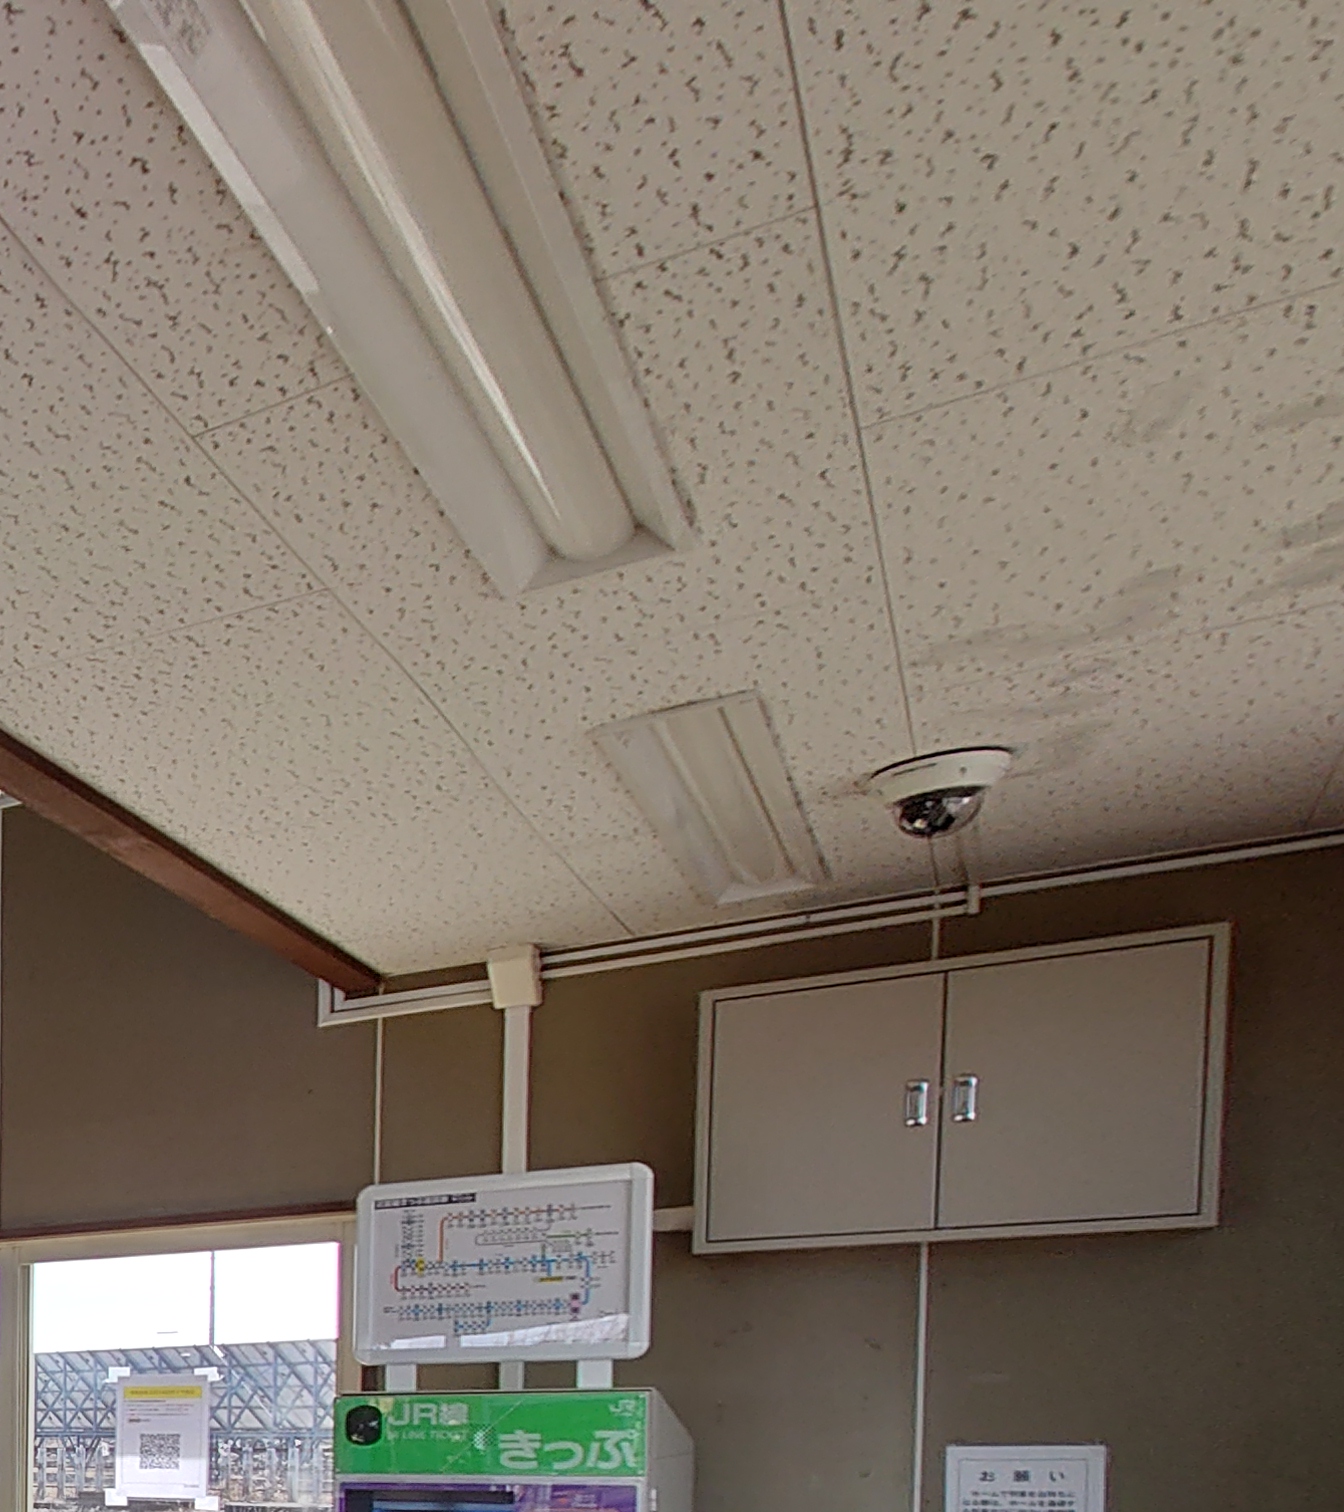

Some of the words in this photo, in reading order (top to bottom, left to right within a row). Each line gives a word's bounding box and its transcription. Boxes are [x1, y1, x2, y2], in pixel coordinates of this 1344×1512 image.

[386, 1403, 468, 1427] JR線
[498, 1429, 640, 1470] きっぷ
[979, 1471, 1064, 1482] お願い
